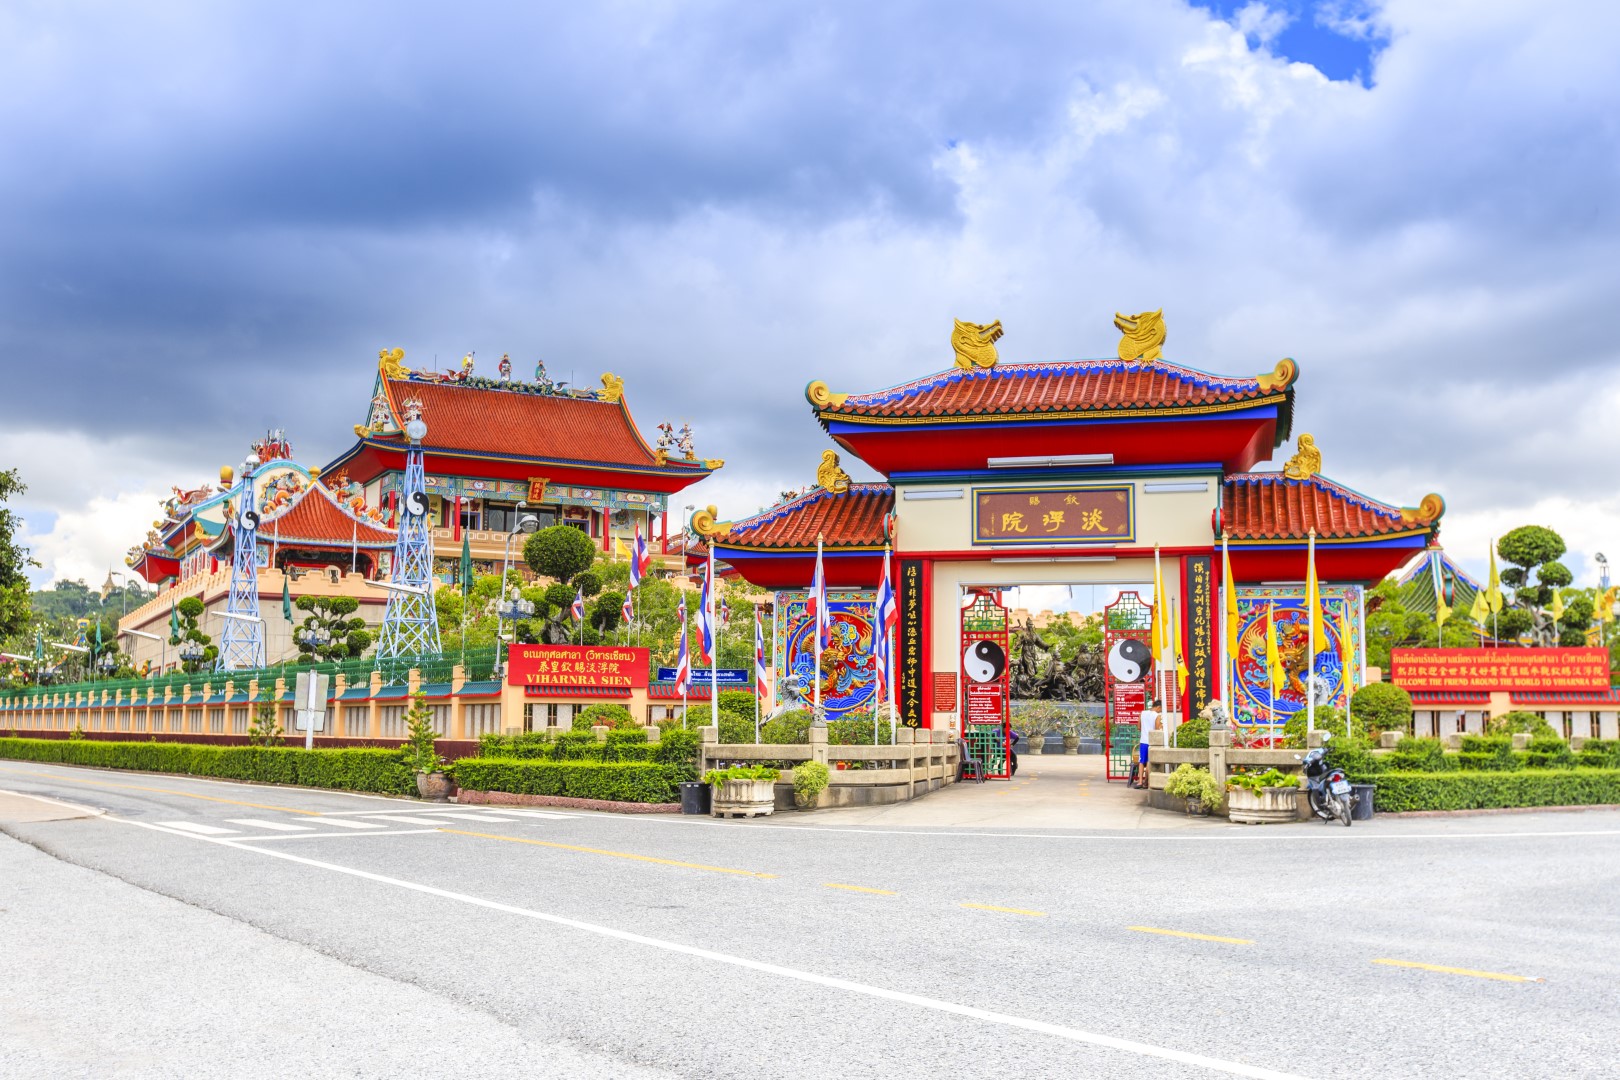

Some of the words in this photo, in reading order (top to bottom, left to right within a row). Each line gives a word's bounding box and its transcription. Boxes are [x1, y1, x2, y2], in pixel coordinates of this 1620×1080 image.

[585, 650, 636, 662] (วิหารเซียน)
[526, 674, 596, 685] VIHARNRA
[601, 675, 632, 686] SIEN
[1393, 678, 1427, 686] WELCOME
[1429, 678, 1442, 686] THE
[1444, 678, 1469, 686] FRIEND
[1470, 678, 1498, 686] AROUND
[1500, 678, 1513, 686] THE
[1514, 678, 1540, 686] WORLD
[1541, 678, 1552, 686] TO
[1592, 678, 1608, 686] SIEN
